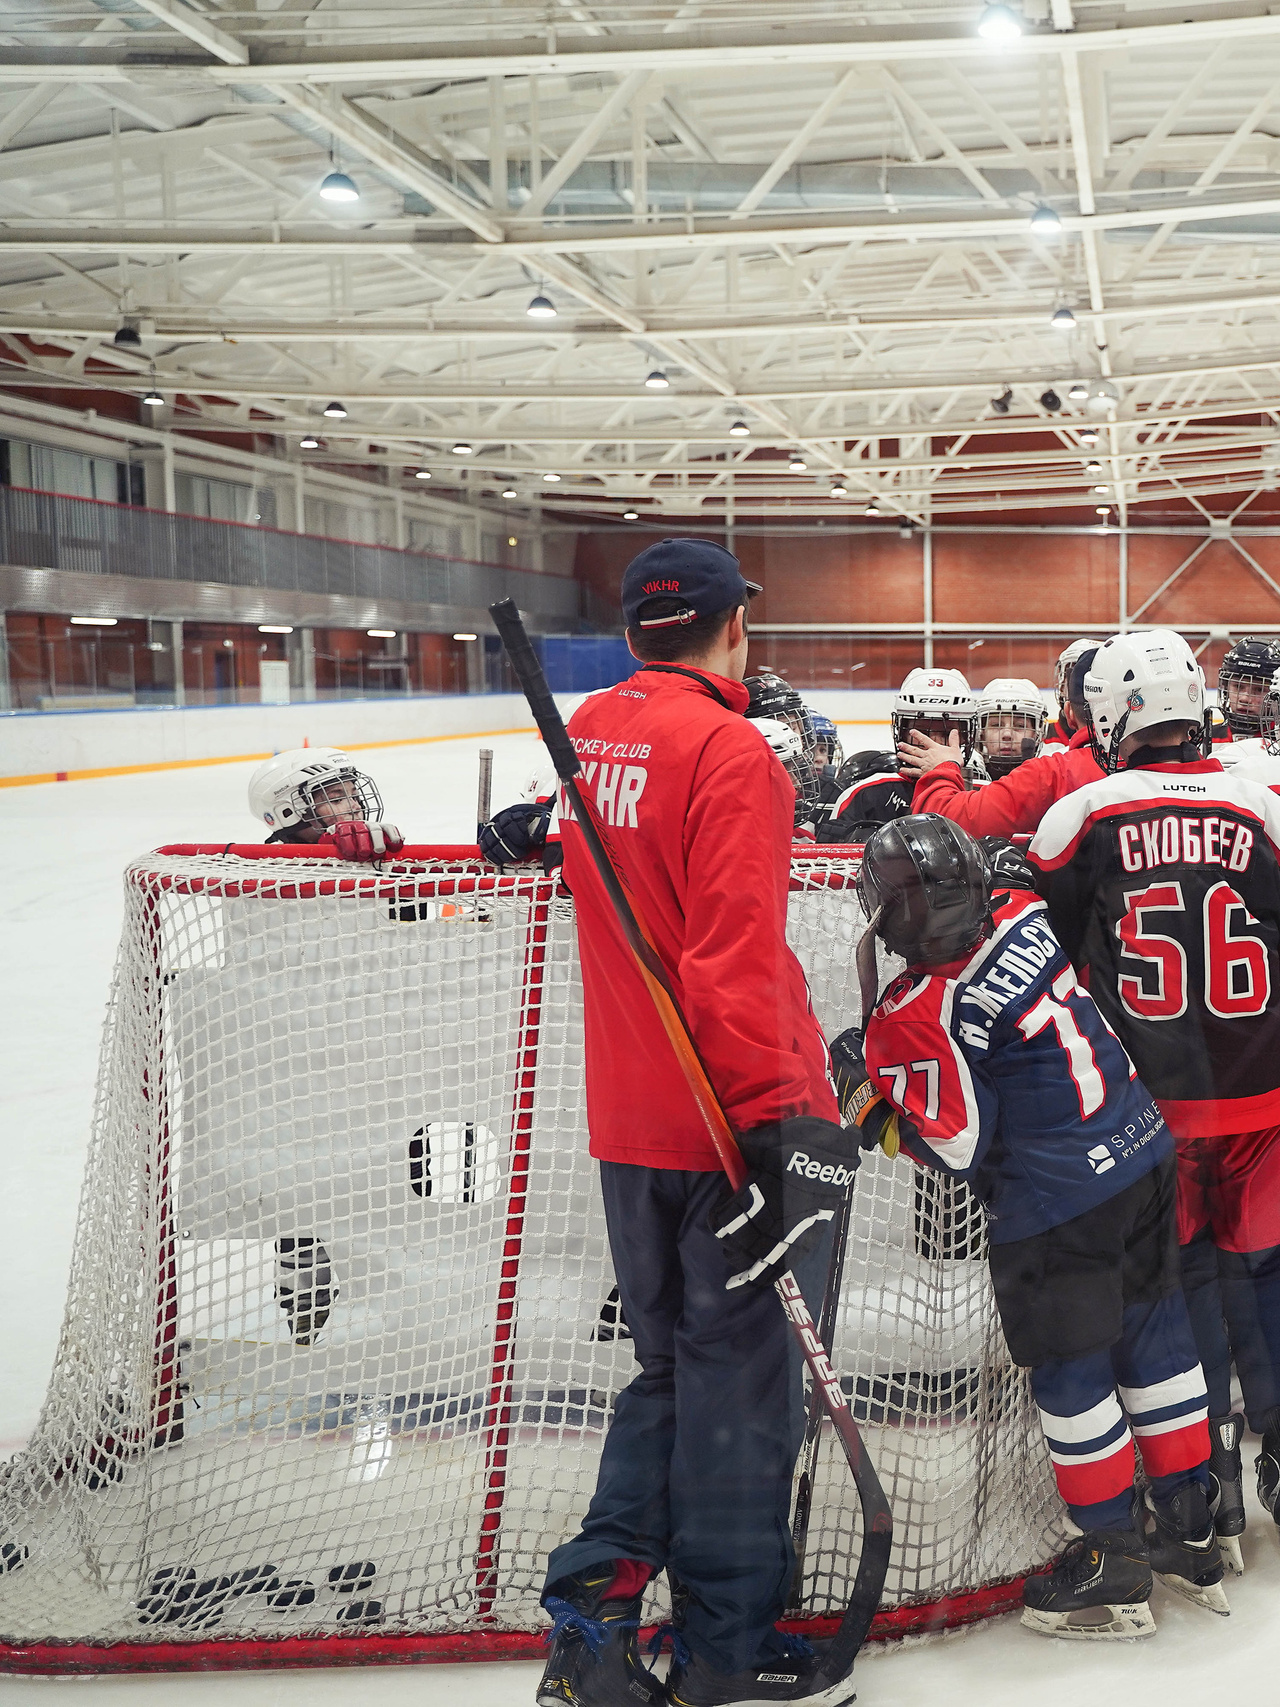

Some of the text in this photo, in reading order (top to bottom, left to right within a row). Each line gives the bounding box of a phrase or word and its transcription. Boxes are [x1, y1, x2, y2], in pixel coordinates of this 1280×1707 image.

[641, 579, 680, 595] VIKHR
[927, 678, 944, 688] 33
[618, 689, 647, 700] LUTCH
[761, 695, 787, 706] BAUER
[612, 743, 652, 759] CLUB
[1162, 784, 1206, 793] LUTCH
[1118, 815, 1253, 874] СКОБЕЕВ
[1115, 880, 1271, 1021] 56
[878, 1058, 941, 1122] 77
[1111, 1100, 1161, 1148] SPINE
[1132, 1141, 1141, 1151] IN
[786, 1151, 856, 1187] Reebo
[1073, 1576, 1105, 1595] BAUER
[760, 1674, 796, 1684] BAUER
